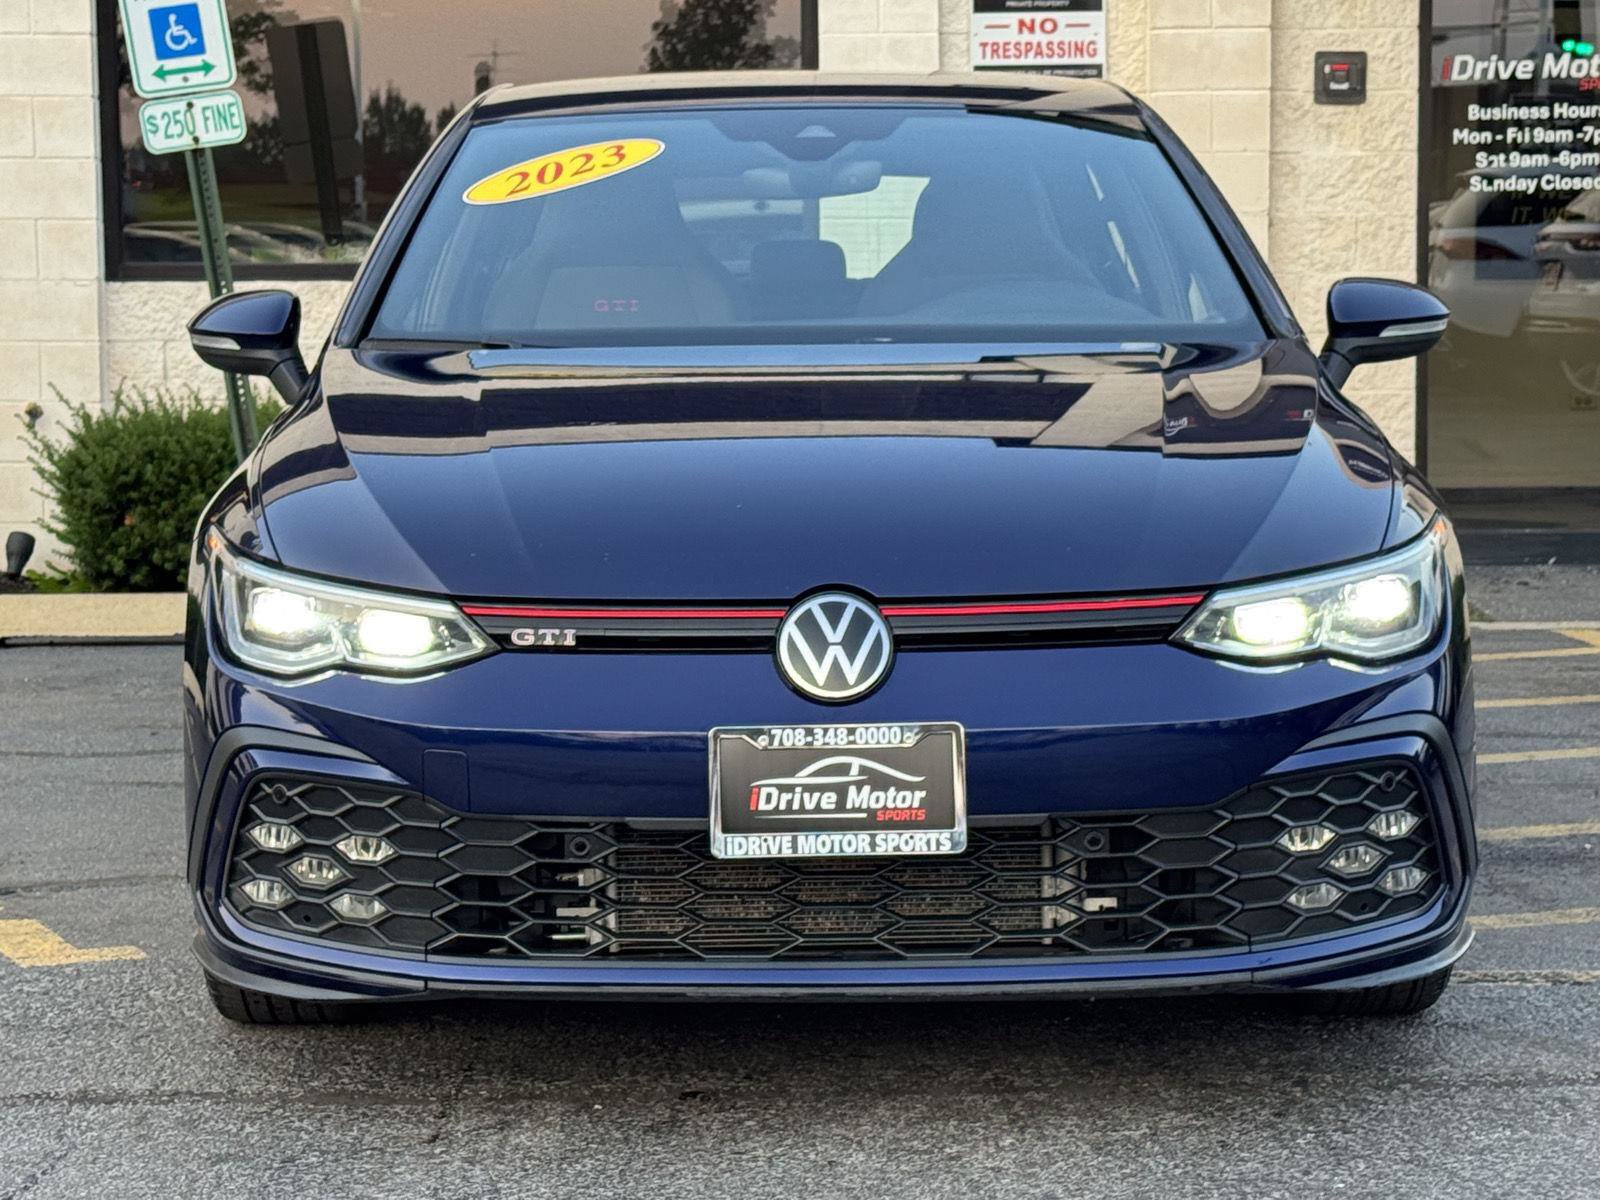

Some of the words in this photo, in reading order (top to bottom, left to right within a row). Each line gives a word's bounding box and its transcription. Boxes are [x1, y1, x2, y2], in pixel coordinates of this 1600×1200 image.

[1017, 18, 1058, 35] NO
[979, 40, 1098, 60] TRESPASSING
[1441, 54, 1535, 81] iDrive
[146, 108, 197, 139] $250
[201, 102, 240, 134] FINE
[1467, 103, 1550, 121] Business
[1553, 102, 1600, 120] Hour
[1452, 128, 1493, 145] Mon
[1533, 126, 1574, 144] 9am
[1475, 151, 1508, 169] Sat
[1509, 151, 1550, 168] 9am
[505, 145, 627, 198] 2023
[1469, 175, 1538, 195] Sunday
[593, 299, 639, 312] GTI
[510, 628, 577, 647] GTI
[771, 726, 901, 747] 708-348-0000
[750, 785, 837, 811] iDrive
[846, 785, 927, 809] Motor
[876, 809, 926, 822] SPORTS
[800, 833, 870, 855] MOTOR
[876, 832, 951, 853] SPORTS
